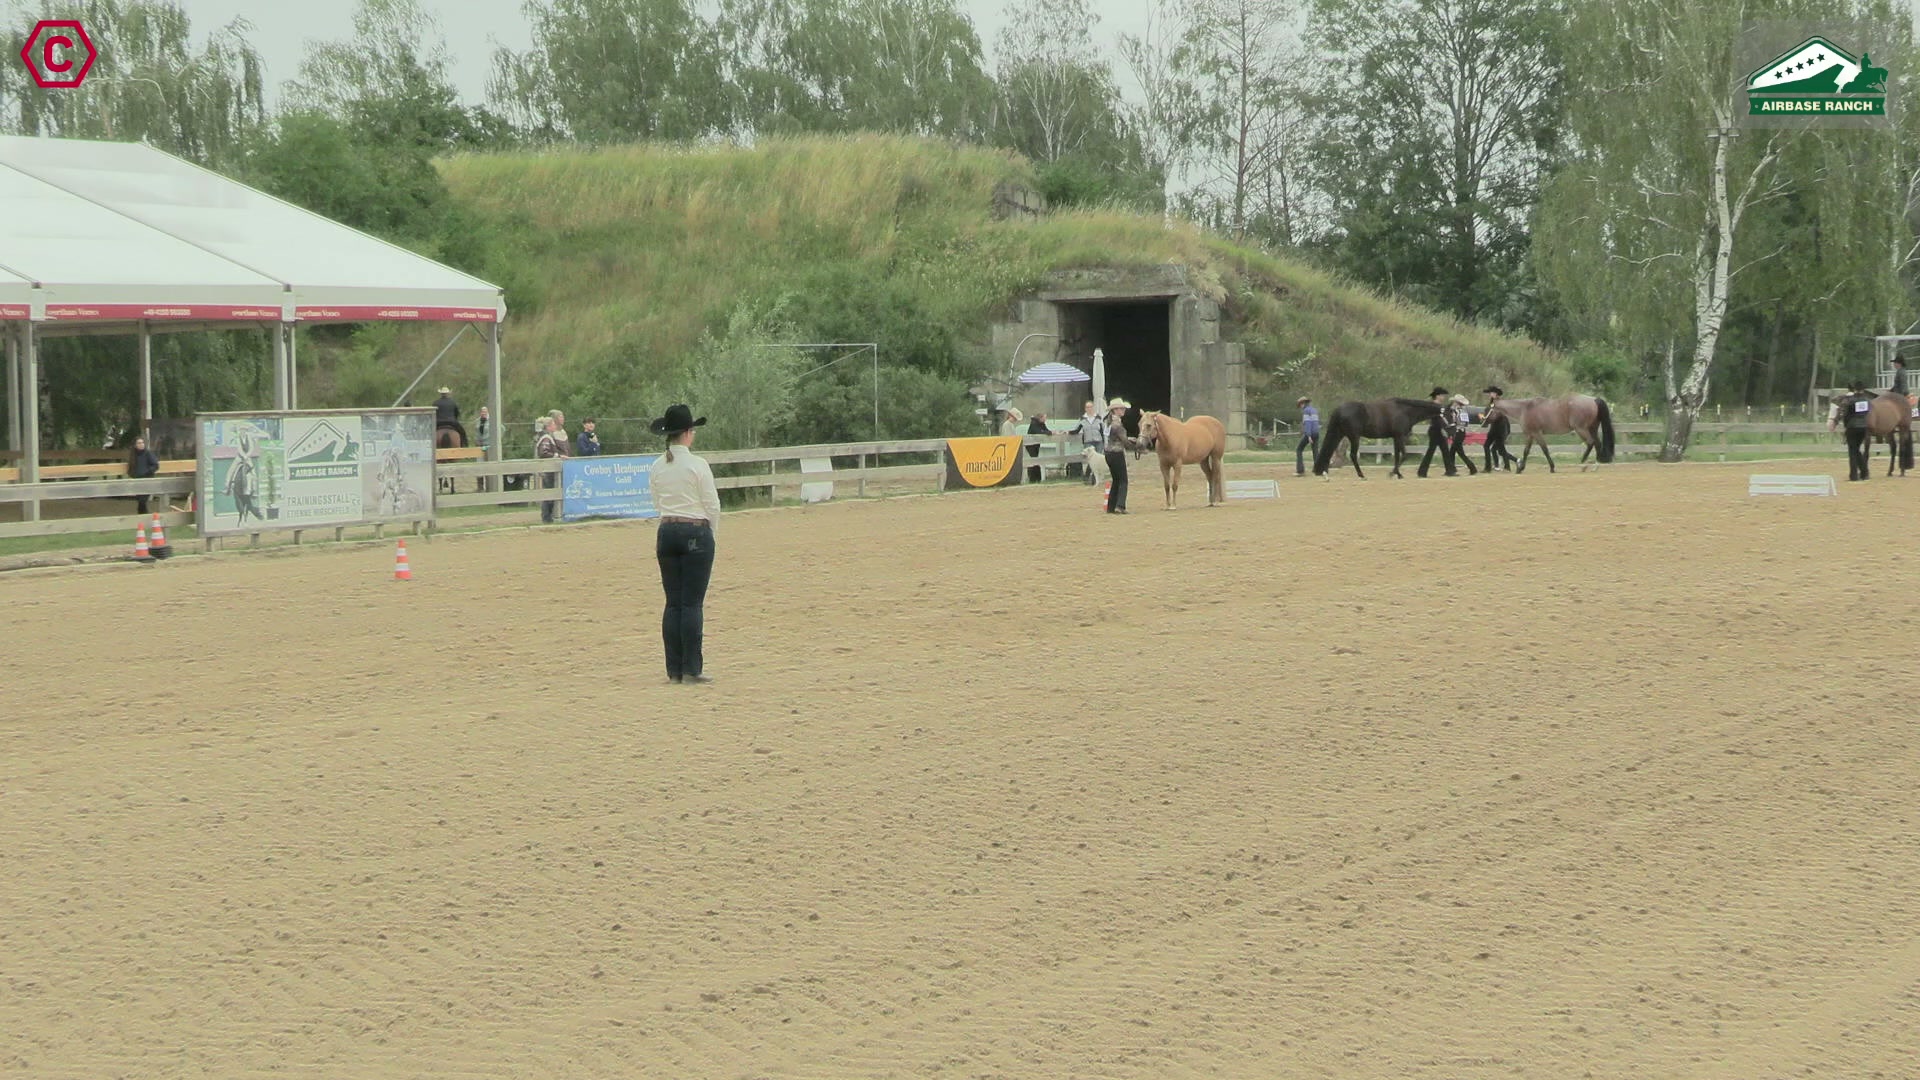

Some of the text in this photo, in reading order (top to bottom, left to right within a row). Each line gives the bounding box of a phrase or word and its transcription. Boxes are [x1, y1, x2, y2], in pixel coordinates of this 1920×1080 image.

[584, 464, 612, 477] Cowboy
[966, 457, 1002, 473] marstall
[295, 466, 353, 477] AIRBASE RANCH
[288, 494, 350, 506] TRAININGSSTALL
